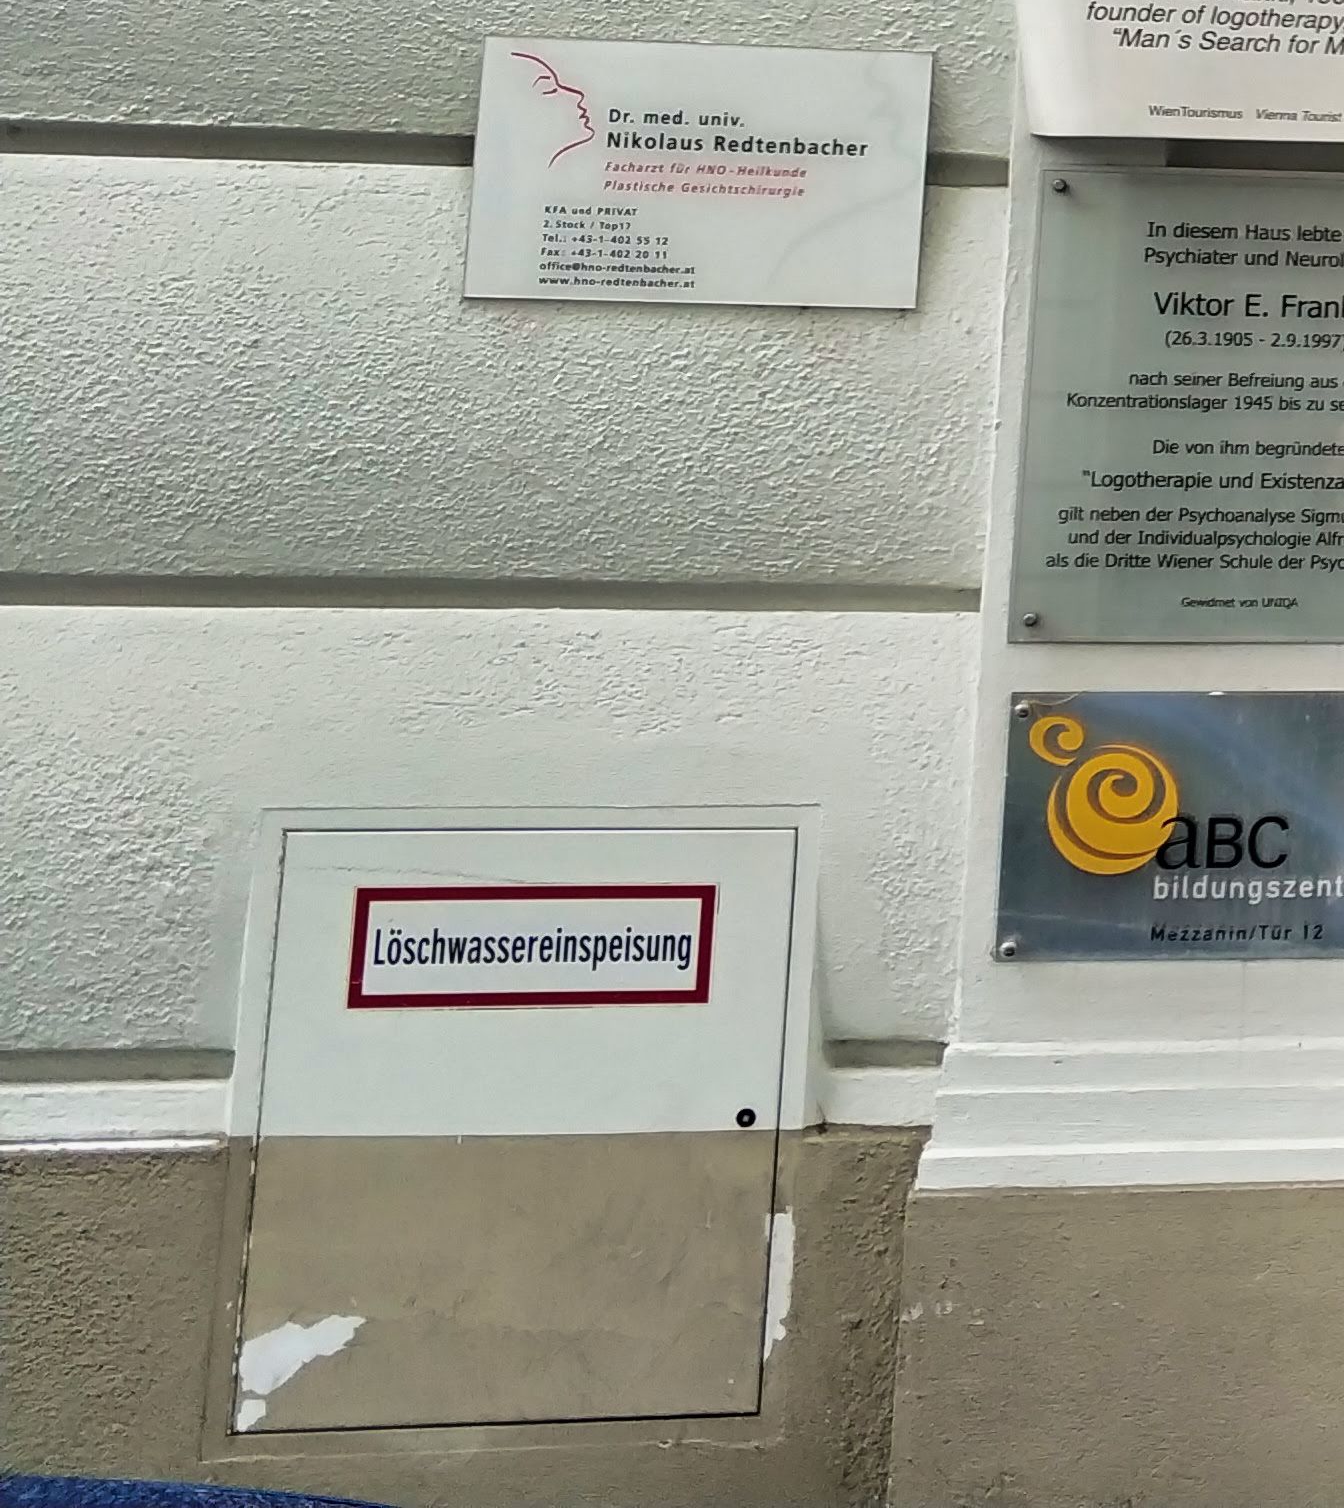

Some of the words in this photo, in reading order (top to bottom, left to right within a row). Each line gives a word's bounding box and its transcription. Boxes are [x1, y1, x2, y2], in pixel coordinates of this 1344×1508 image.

[1087, 1, 1177, 23] founder
[1181, 5, 1207, 24] of
[1199, 31, 1281, 52] Search
[1288, 34, 1320, 54] for
[609, 108, 634, 123] Dr.
[643, 110, 689, 125] med.
[699, 112, 744, 127] univ.
[1256, 109, 1298, 121] Vienna
[1301, 110, 1343, 122] Tourist
[607, 131, 703, 151] Nikolaus
[713, 135, 868, 156] Redtenbacher
[604, 161, 664, 173] Facharzt
[670, 162, 690, 174] für
[603, 180, 675, 192] Plastische
[681, 183, 805, 199] Gesichtschirurgie
[572, 206, 592, 215] und
[597, 207, 638, 216] PRIVAT
[555, 219, 585, 229] Stock
[1147, 222, 1166, 237] In
[1173, 222, 1238, 239] diesem
[1245, 224, 1291, 241] Haus
[1296, 225, 1342, 242] lebte
[636, 236, 650, 246] 55
[655, 237, 668, 245] 12
[635, 250, 649, 259] 20
[655, 251, 667, 259] 11
[1144, 247, 1238, 267] Psychiater
[1244, 250, 1279, 266] und
[539, 261, 695, 274] office@hno-redtenbacher.at
[539, 276, 695, 288] www.hno-redtenbacher.at
[1154, 292, 1235, 316] Viktor
[1245, 294, 1268, 317] E.
[1165, 330, 1253, 348] (26.3.1905
[1129, 371, 1168, 386] nach
[1173, 375, 1223, 387] seiner
[1228, 372, 1304, 392] Befreiung
[1309, 377, 1338, 389] aus
[1067, 393, 1228, 413] Konzentrationslager
[1234, 396, 1273, 410] 1945
[1278, 396, 1301, 411] bis
[1305, 400, 1324, 411] zu
[1153, 439, 1180, 454] Die
[1185, 443, 1214, 454] von
[1220, 440, 1249, 455] ihm
[1219, 472, 1254, 489] und
[1058, 506, 1084, 524] gilt
[1090, 506, 1140, 522] neben
[1145, 506, 1174, 522] der
[1178, 507, 1296, 526] Psychoanalyse
[1068, 529, 1099, 544] und
[1104, 529, 1132, 545] der
[1137, 530, 1311, 550] Individualpsychologie
[1046, 553, 1069, 568] als
[1074, 553, 1099, 568] die
[1105, 553, 1151, 568] Dritte
[1157, 554, 1215, 569] Wiener
[1219, 554, 1273, 569] Schule
[1278, 554, 1306, 569] der
[1239, 599, 1258, 608] von
[1150, 924, 1293, 942] Mezzanin/Tür
[1302, 924, 1323, 941] 12
[373, 927, 692, 971] Löschwassereinspeisung
